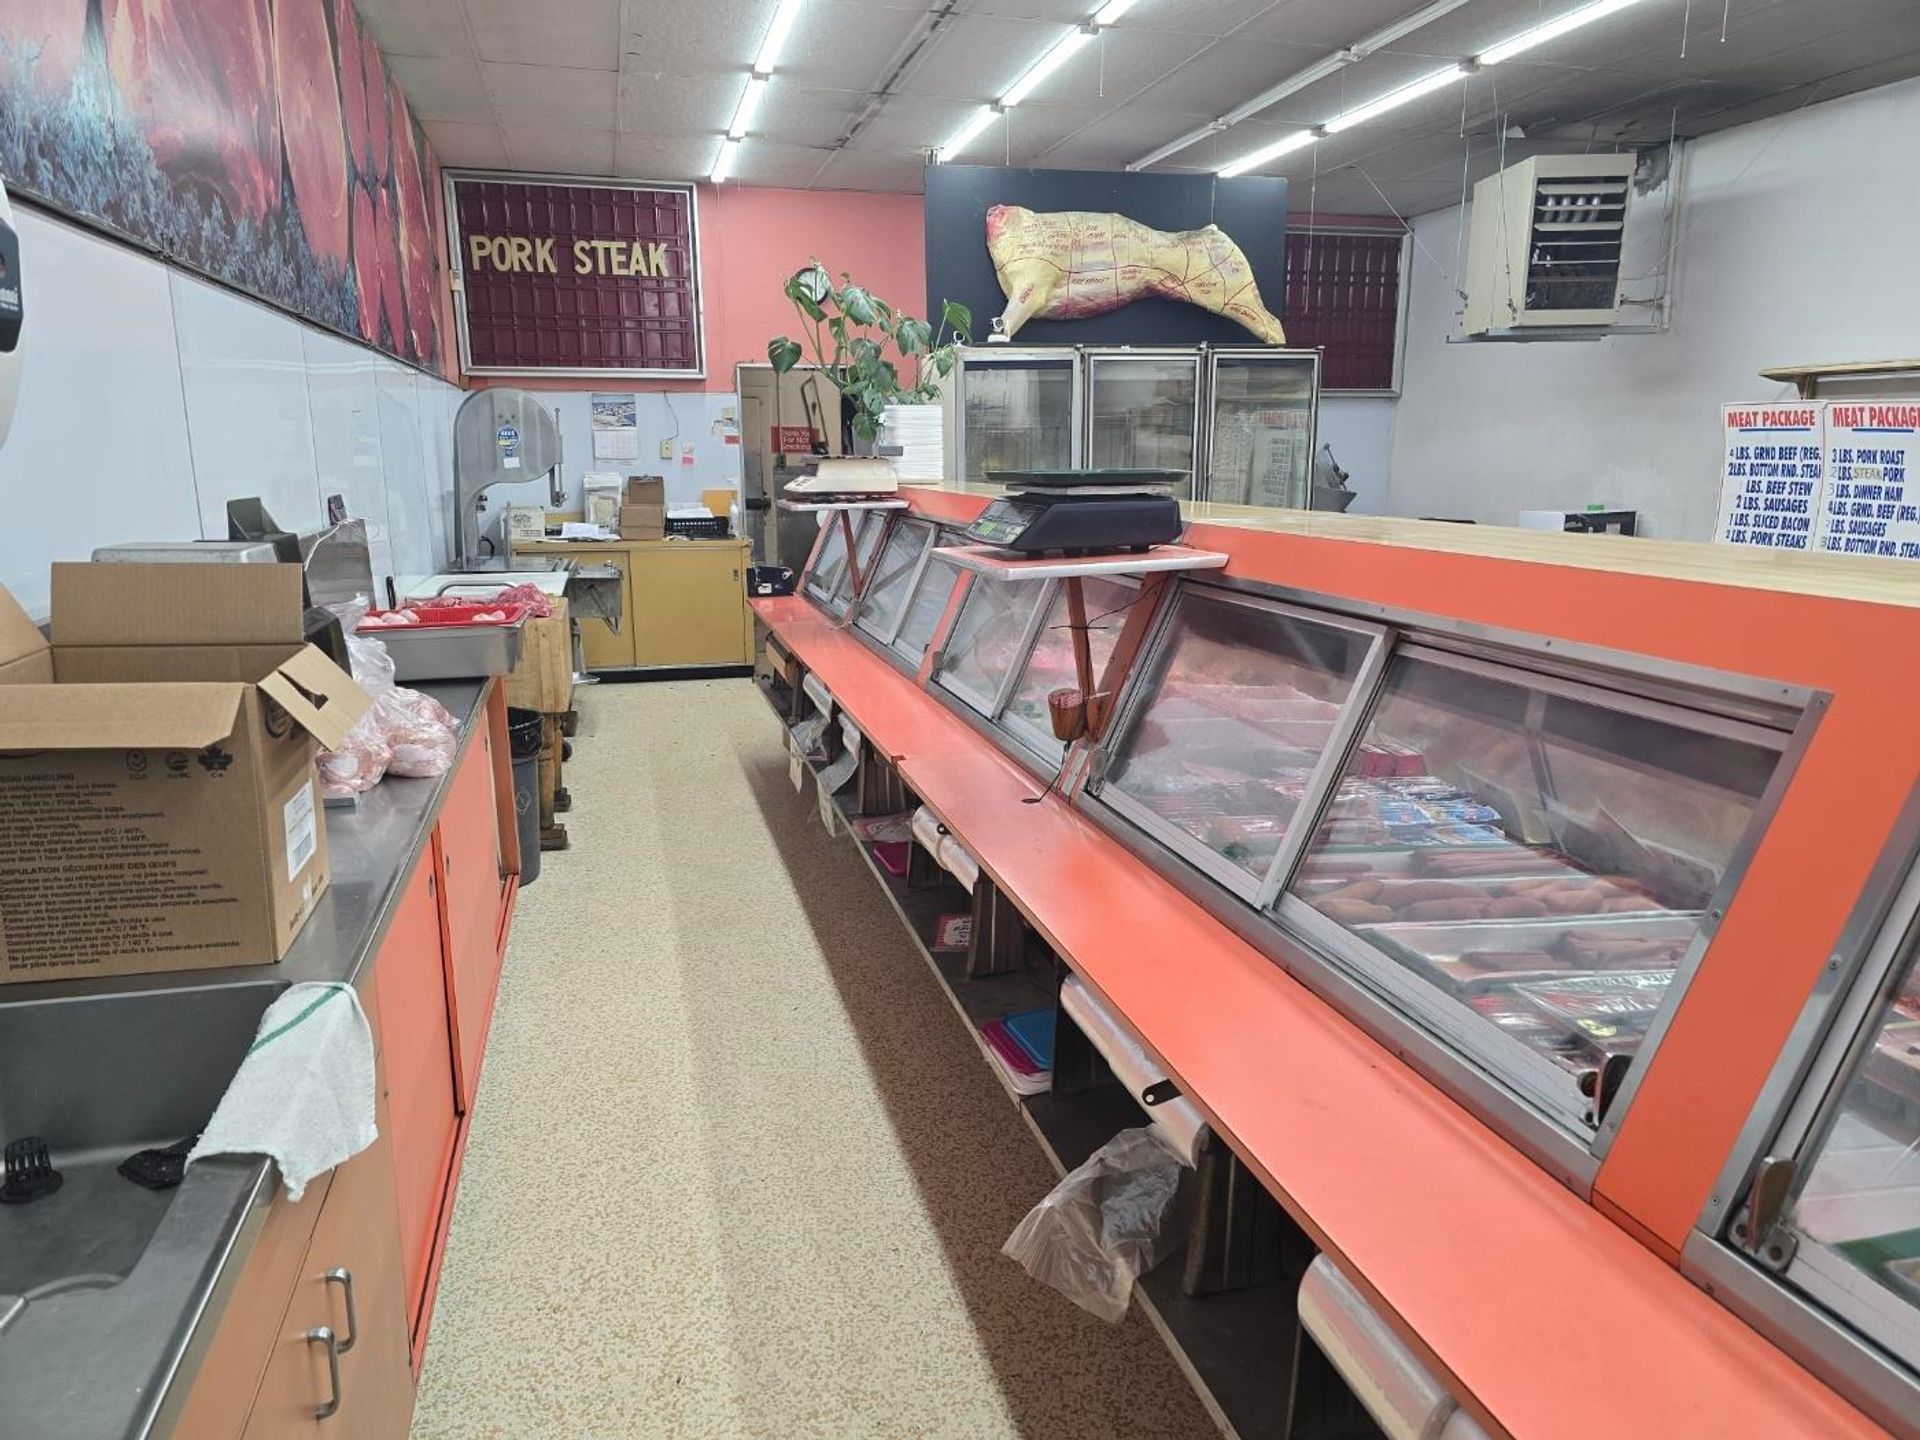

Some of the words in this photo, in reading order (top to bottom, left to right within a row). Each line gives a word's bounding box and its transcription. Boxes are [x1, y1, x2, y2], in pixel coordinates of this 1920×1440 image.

[469, 235, 558, 274] PORK
[573, 240, 670, 277] STEAK
[1728, 411, 1759, 427] MEAT
[1762, 410, 1816, 426] PACKAGE
[1833, 407, 1865, 427] MEAT
[1736, 446, 1751, 460] LBS.
[1754, 446, 1776, 460] GRND
[1779, 446, 1798, 460] BEEF
[1832, 448, 1837, 463] 3
[1839, 448, 1854, 463] LBS.
[1857, 449, 1878, 464] PORK
[1880, 450, 1905, 465] ROAST
[1749, 463, 1779, 477] BOTTOM
[1781, 463, 1799, 477] RND.
[1838, 466, 1852, 481] LBS.
[1883, 467, 1906, 483] PORK
[1746, 480, 1763, 494] LBS.
[1766, 481, 1786, 494] BEEF
[1788, 482, 1813, 496] STEW
[1836, 484, 1851, 498] LBS.
[1853, 485, 1883, 500] DINNER
[1884, 486, 1904, 502] HAM
[1736, 494, 1741, 508] 2
[1743, 497, 1760, 511] LBS.
[1763, 498, 1808, 514] SAUSAGES
[1851, 503, 1874, 518] GRND.
[1877, 504, 1896, 519] BEEF
[1729, 513, 1733, 526] 1
[1734, 513, 1750, 527] LBS.
[1752, 515, 1779, 529] SLICED
[1781, 516, 1810, 532] BACON
[1830, 519, 1846, 534] LBS.
[1848, 520, 1887, 537] SAUSAGES
[1731, 530, 1747, 543] LBS.
[1750, 531, 1775, 546] PORK
[1775, 533, 1807, 549] STEAKS
[1827, 536, 1842, 551] LBS.
[1844, 538, 1878, 554] BOTTOM
[1878, 541, 1897, 556] RND.
